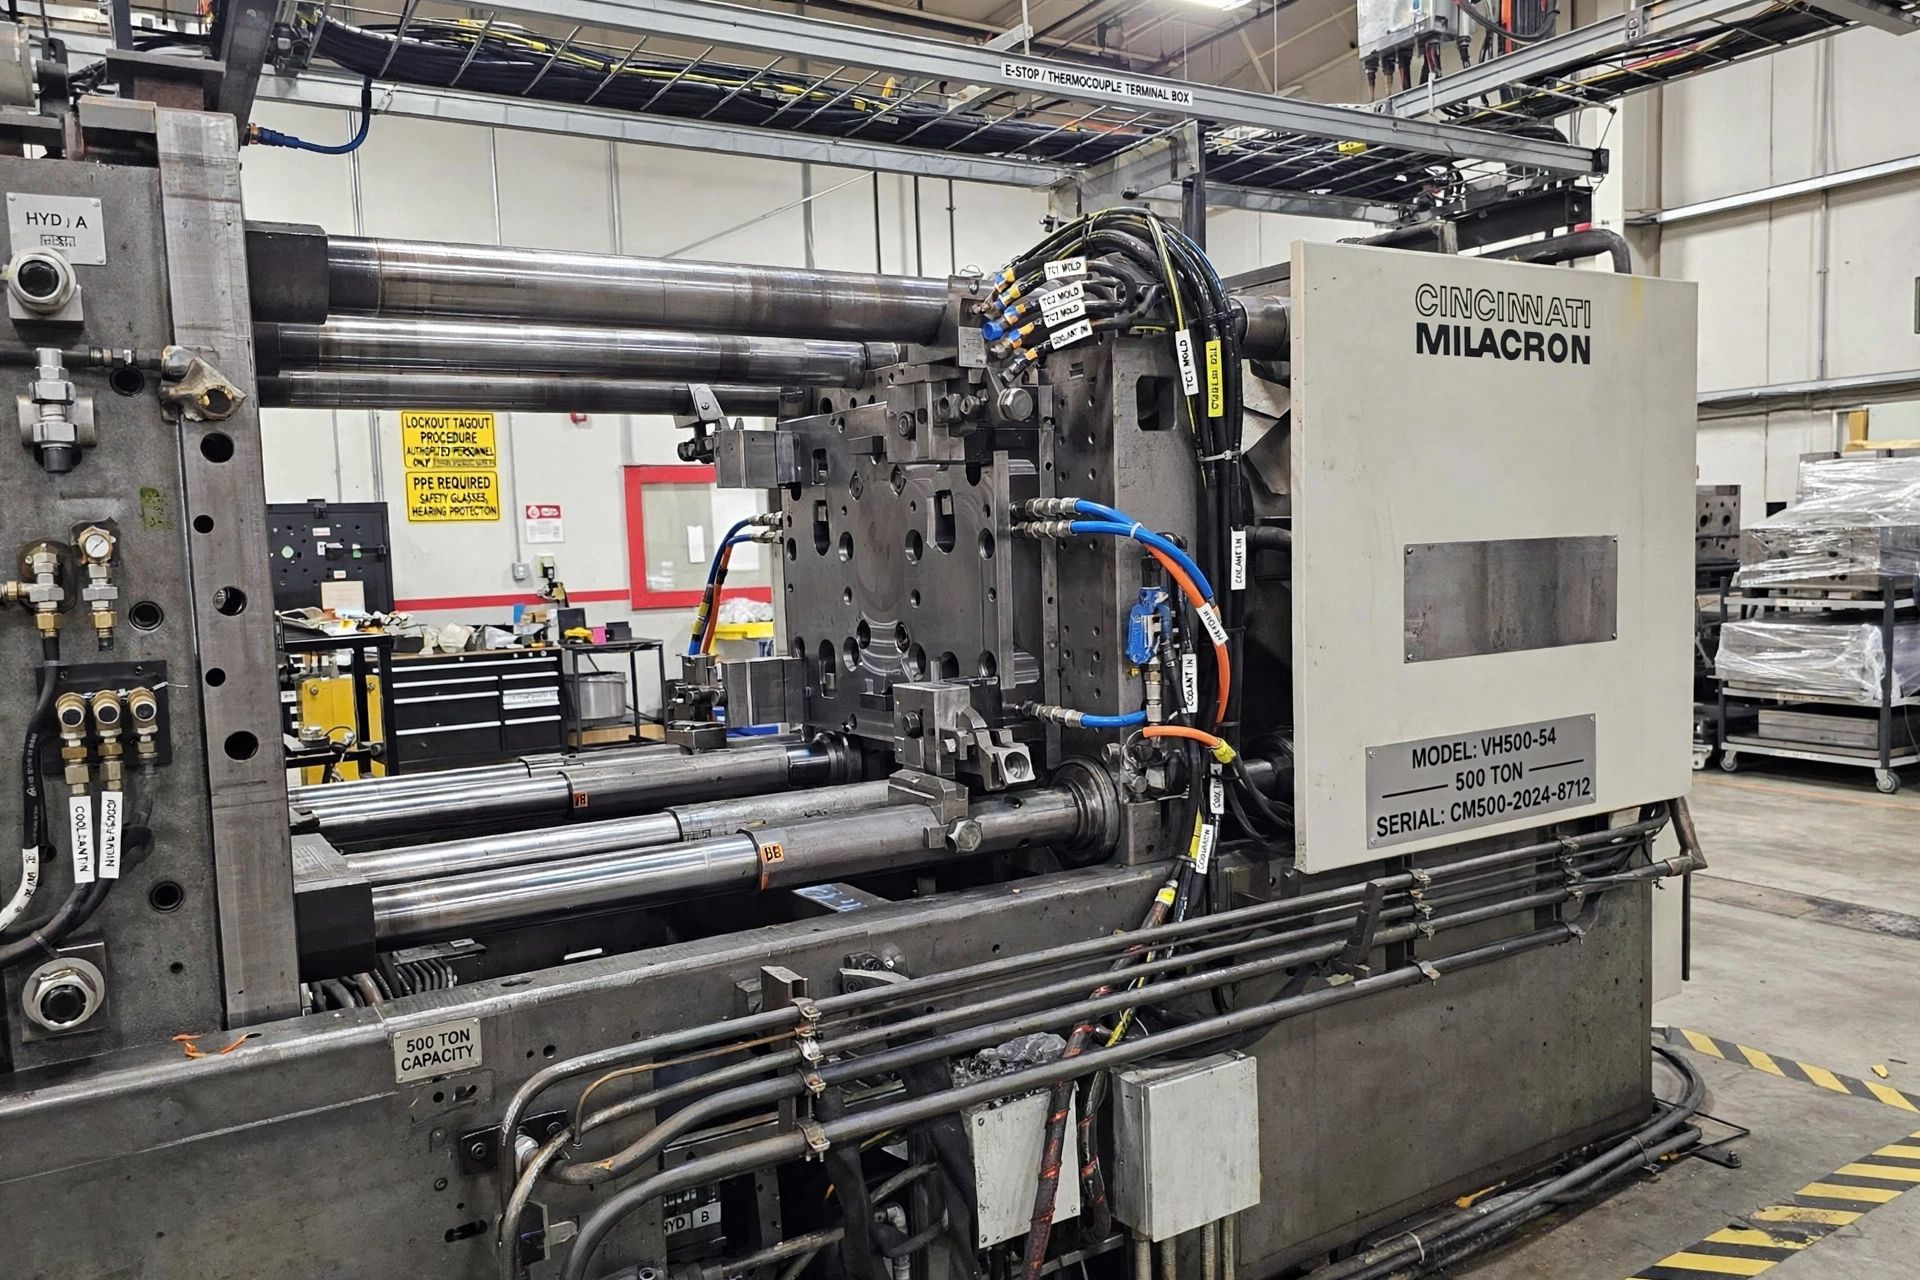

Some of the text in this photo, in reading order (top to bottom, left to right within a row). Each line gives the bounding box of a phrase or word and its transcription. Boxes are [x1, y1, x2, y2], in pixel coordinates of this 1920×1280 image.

[1005, 64, 1040, 80] E-STOP
[1048, 71, 1122, 93] THERMOCOUPLE
[1125, 84, 1169, 100] TERMINAL
[1172, 91, 1190, 104] BOX
[26, 211, 88, 229] HYD A
[1415, 283, 1591, 329] CINCINNATI
[1416, 322, 1591, 365] MILACRON
[405, 416, 490, 429] LOCKOUT TAGOUT
[420, 431, 477, 444] PROCEDURE
[413, 476, 491, 490] PPE REQUIRED
[420, 493, 447, 504] SAFETY
[412, 507, 446, 517] HEARING
[1412, 727, 1557, 769] MODEL: VH500-54
[1456, 761, 1523, 791] 500 TON
[1376, 776, 1591, 838] SERIAL: CM500-2024-8712
[406, 1028, 470, 1053] 500 TON
[401, 1044, 474, 1072] CAPACITY
[701, 1211, 710, 1223] B
